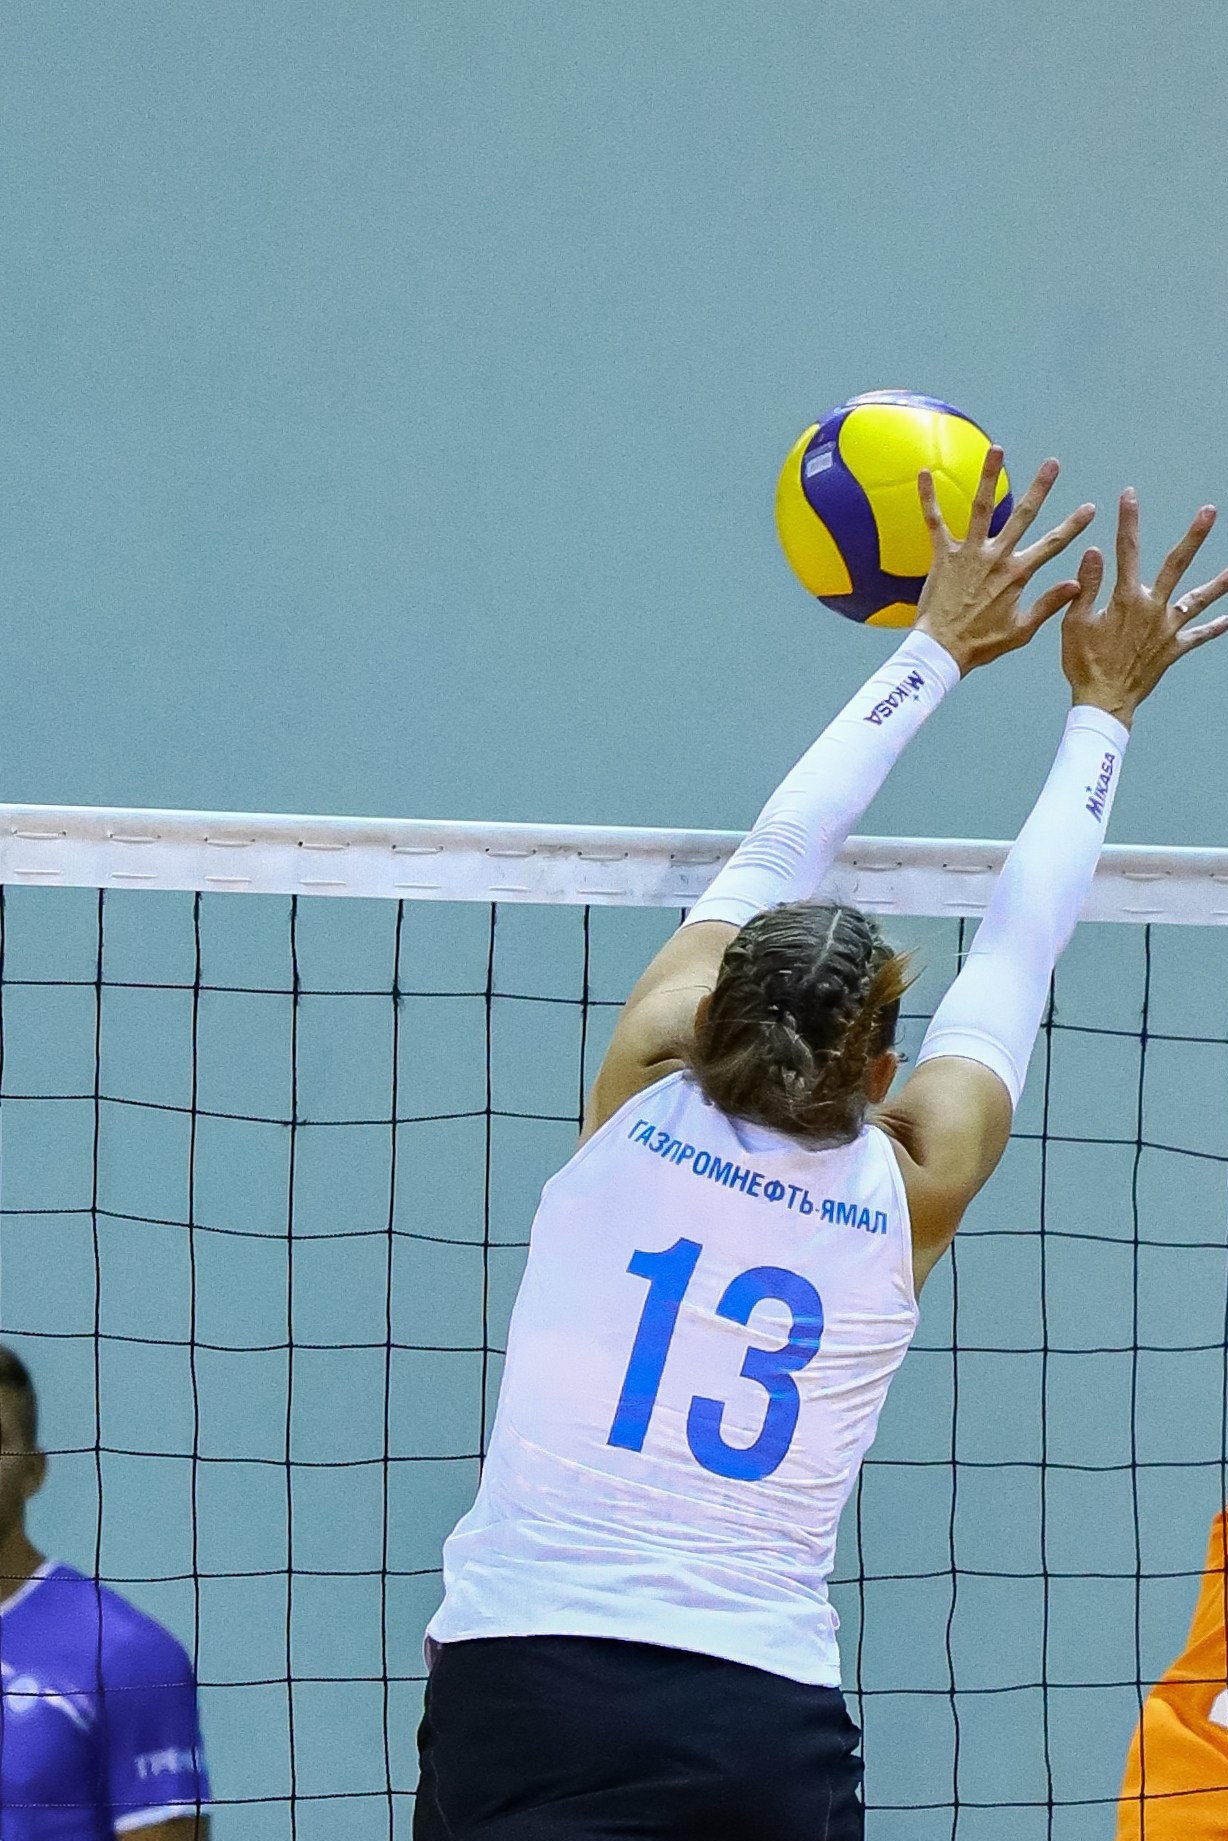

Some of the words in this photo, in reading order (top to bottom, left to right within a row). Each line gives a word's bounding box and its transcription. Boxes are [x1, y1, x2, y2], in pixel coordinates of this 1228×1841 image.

[863, 669, 925, 726] MIKASA
[1085, 751, 1116, 824] MIKASA
[626, 1118, 889, 1235] ГАЗПРОМНЕФТЬ-ЯМАЛ
[606, 1236, 825, 1482] 13
